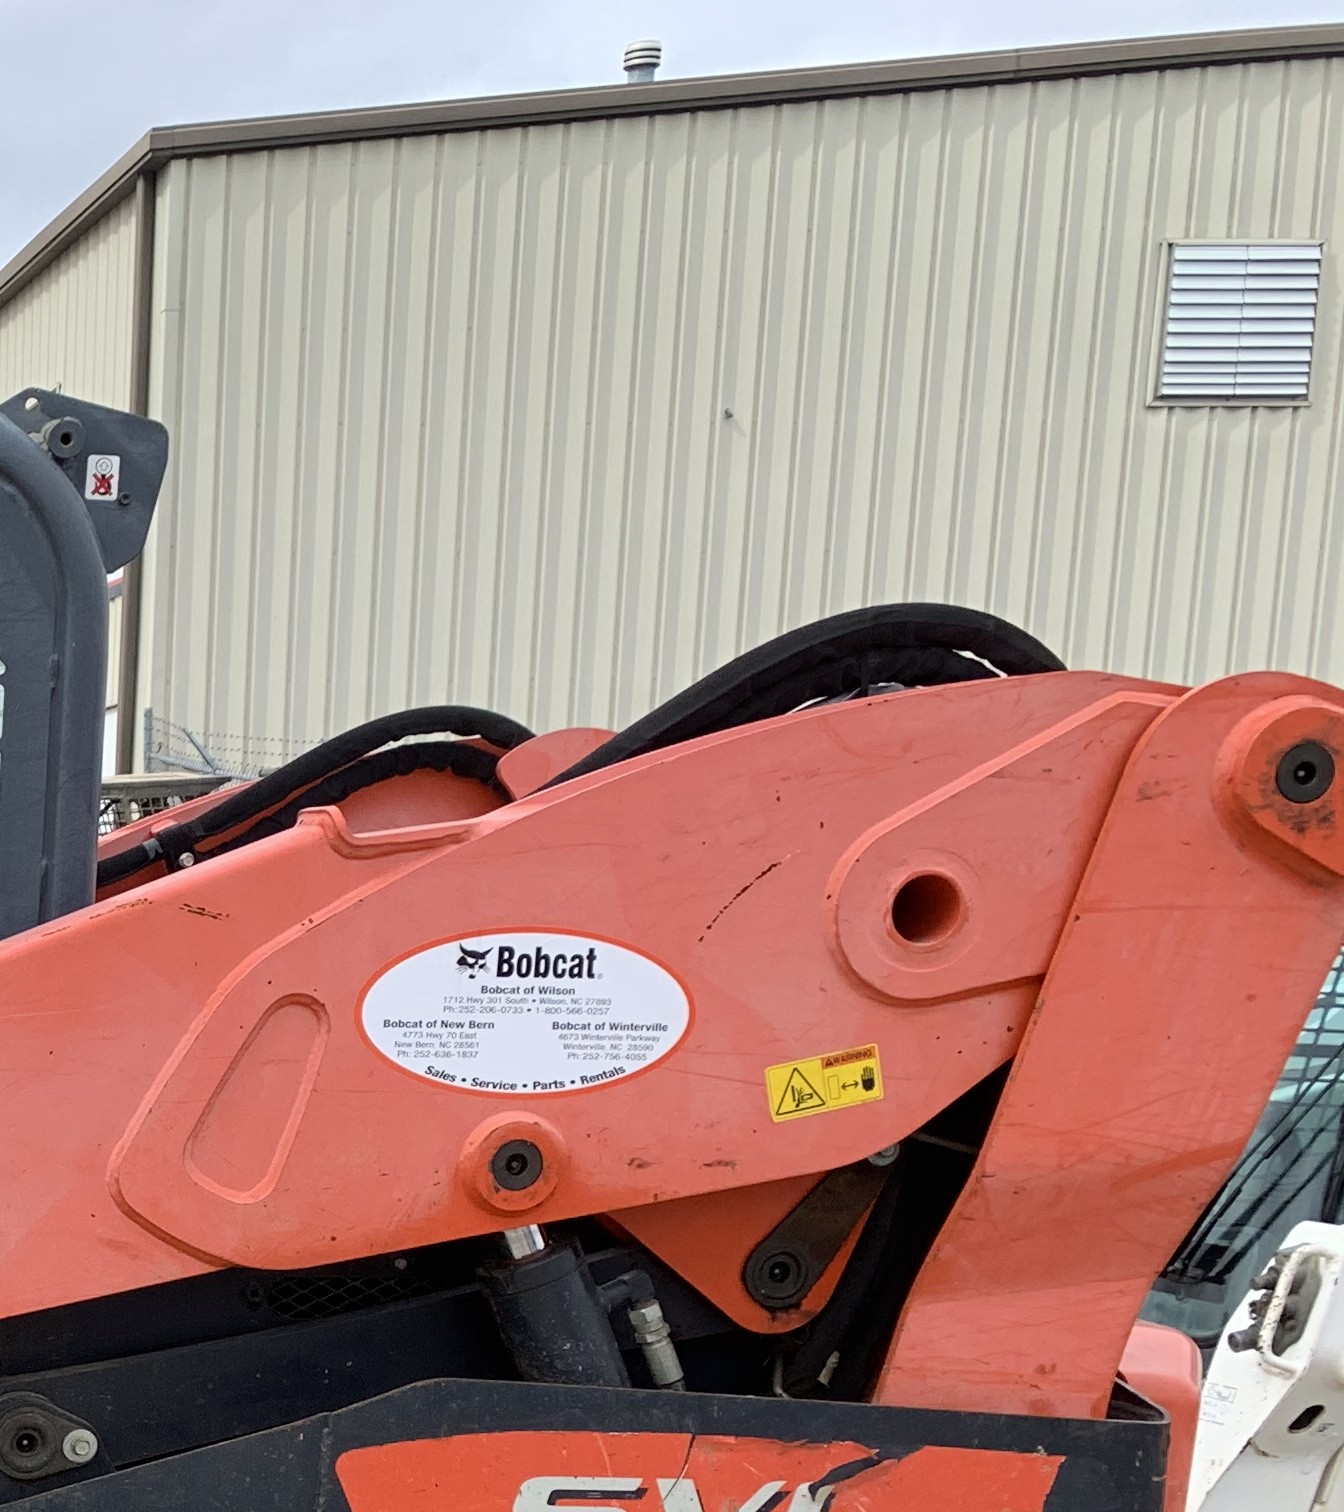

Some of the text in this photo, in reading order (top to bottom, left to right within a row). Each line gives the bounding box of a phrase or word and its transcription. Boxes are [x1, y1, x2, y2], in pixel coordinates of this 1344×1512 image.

[496, 946, 597, 979] Bobcat
[480, 985, 575, 995] Bobcat of Wilson
[443, 996, 464, 1004] 1712
[466, 997, 484, 1005] Hwy
[505, 997, 529, 1005] South
[570, 998, 584, 1006] NC
[383, 1019, 495, 1029] Bobcat of New Bern
[552, 1021, 668, 1031] Bobcat of Winterville
[402, 1031, 423, 1039] 4773
[426, 1032, 443, 1040] Hwy
[581, 1033, 623, 1041] Winterville
[626, 1034, 661, 1043] Parkway
[439, 1041, 452, 1049] NC
[610, 1043, 622, 1051] NC
[425, 1065, 626, 1090] Sales Service Parts Rentals
